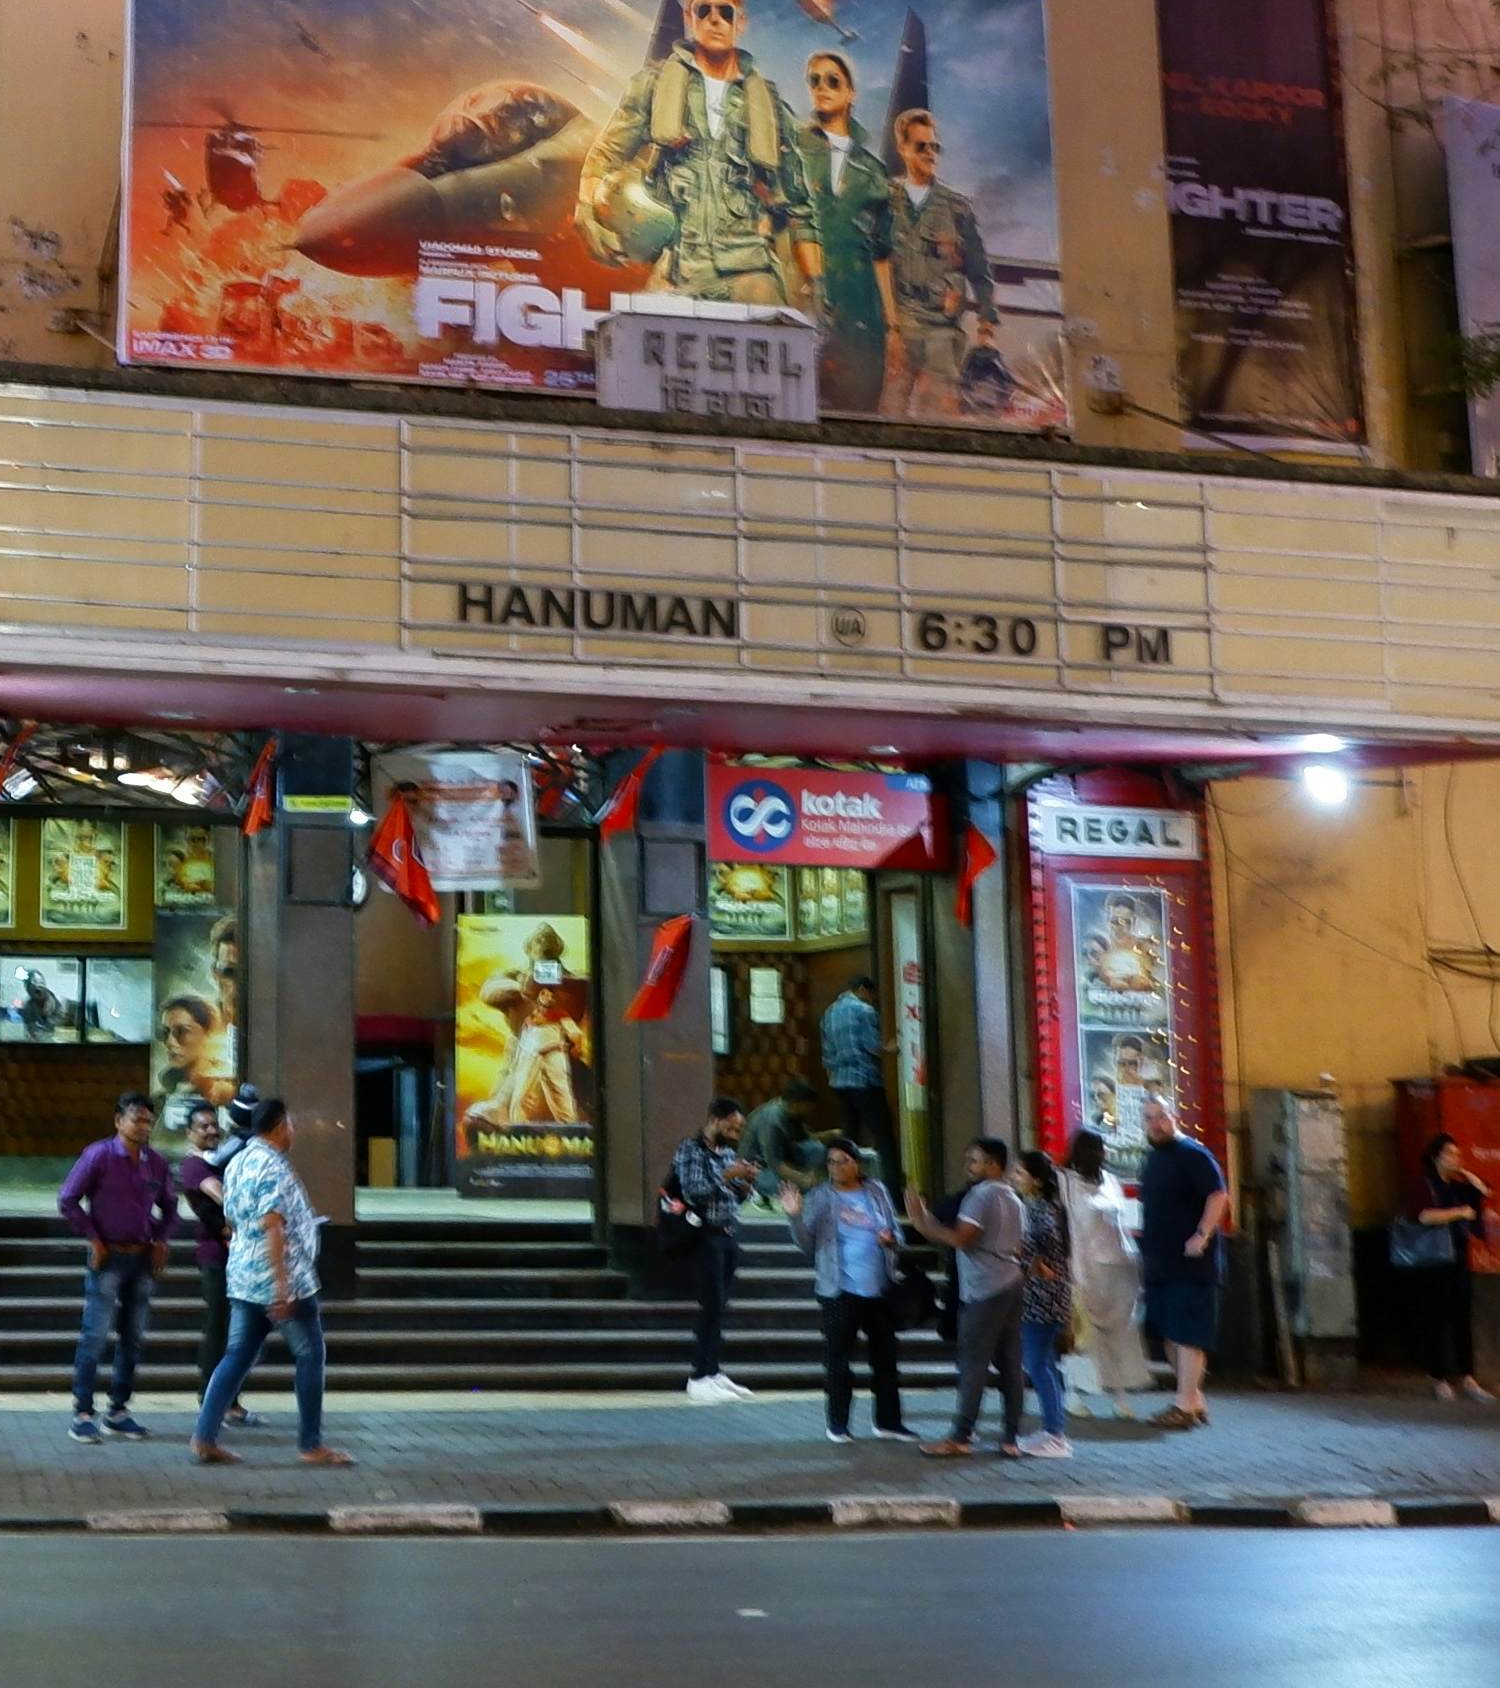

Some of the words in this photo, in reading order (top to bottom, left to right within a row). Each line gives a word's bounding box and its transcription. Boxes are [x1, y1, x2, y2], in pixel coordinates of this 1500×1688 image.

[132, 338, 197, 359] IMAX
[643, 329, 803, 378] REGAL
[457, 581, 738, 639] HANUMAN
[918, 610, 1038, 657] 6:30
[1101, 624, 1171, 663] PM
[801, 789, 883, 820] kotak
[1056, 815, 1181, 849] REGAL
